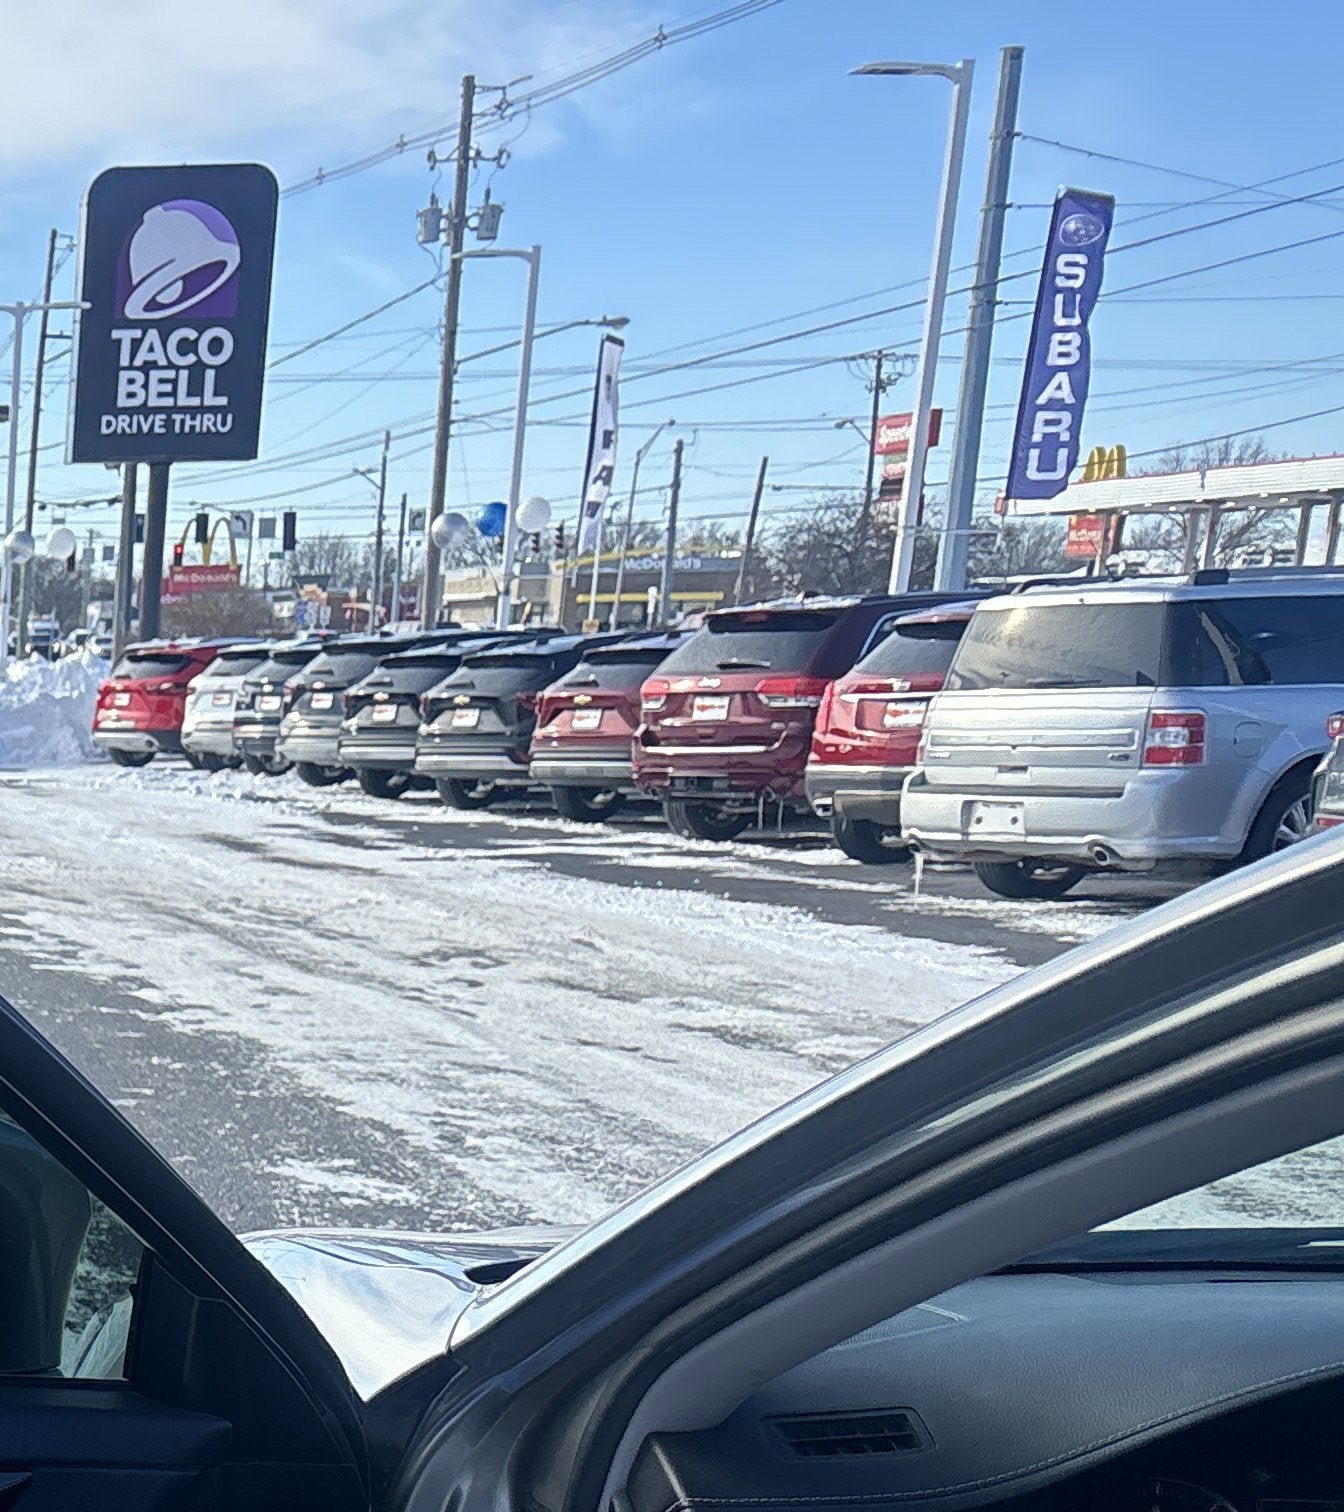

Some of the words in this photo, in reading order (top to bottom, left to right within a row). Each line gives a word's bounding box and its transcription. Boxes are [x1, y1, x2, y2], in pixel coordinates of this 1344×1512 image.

[111, 327, 234, 367] TACO
[1025, 253, 1089, 481] SUBARU
[116, 369, 228, 408] BELL
[100, 414, 167, 435] DRIVE
[172, 413, 233, 433] THRU
[624, 557, 701, 570] McDoald's
